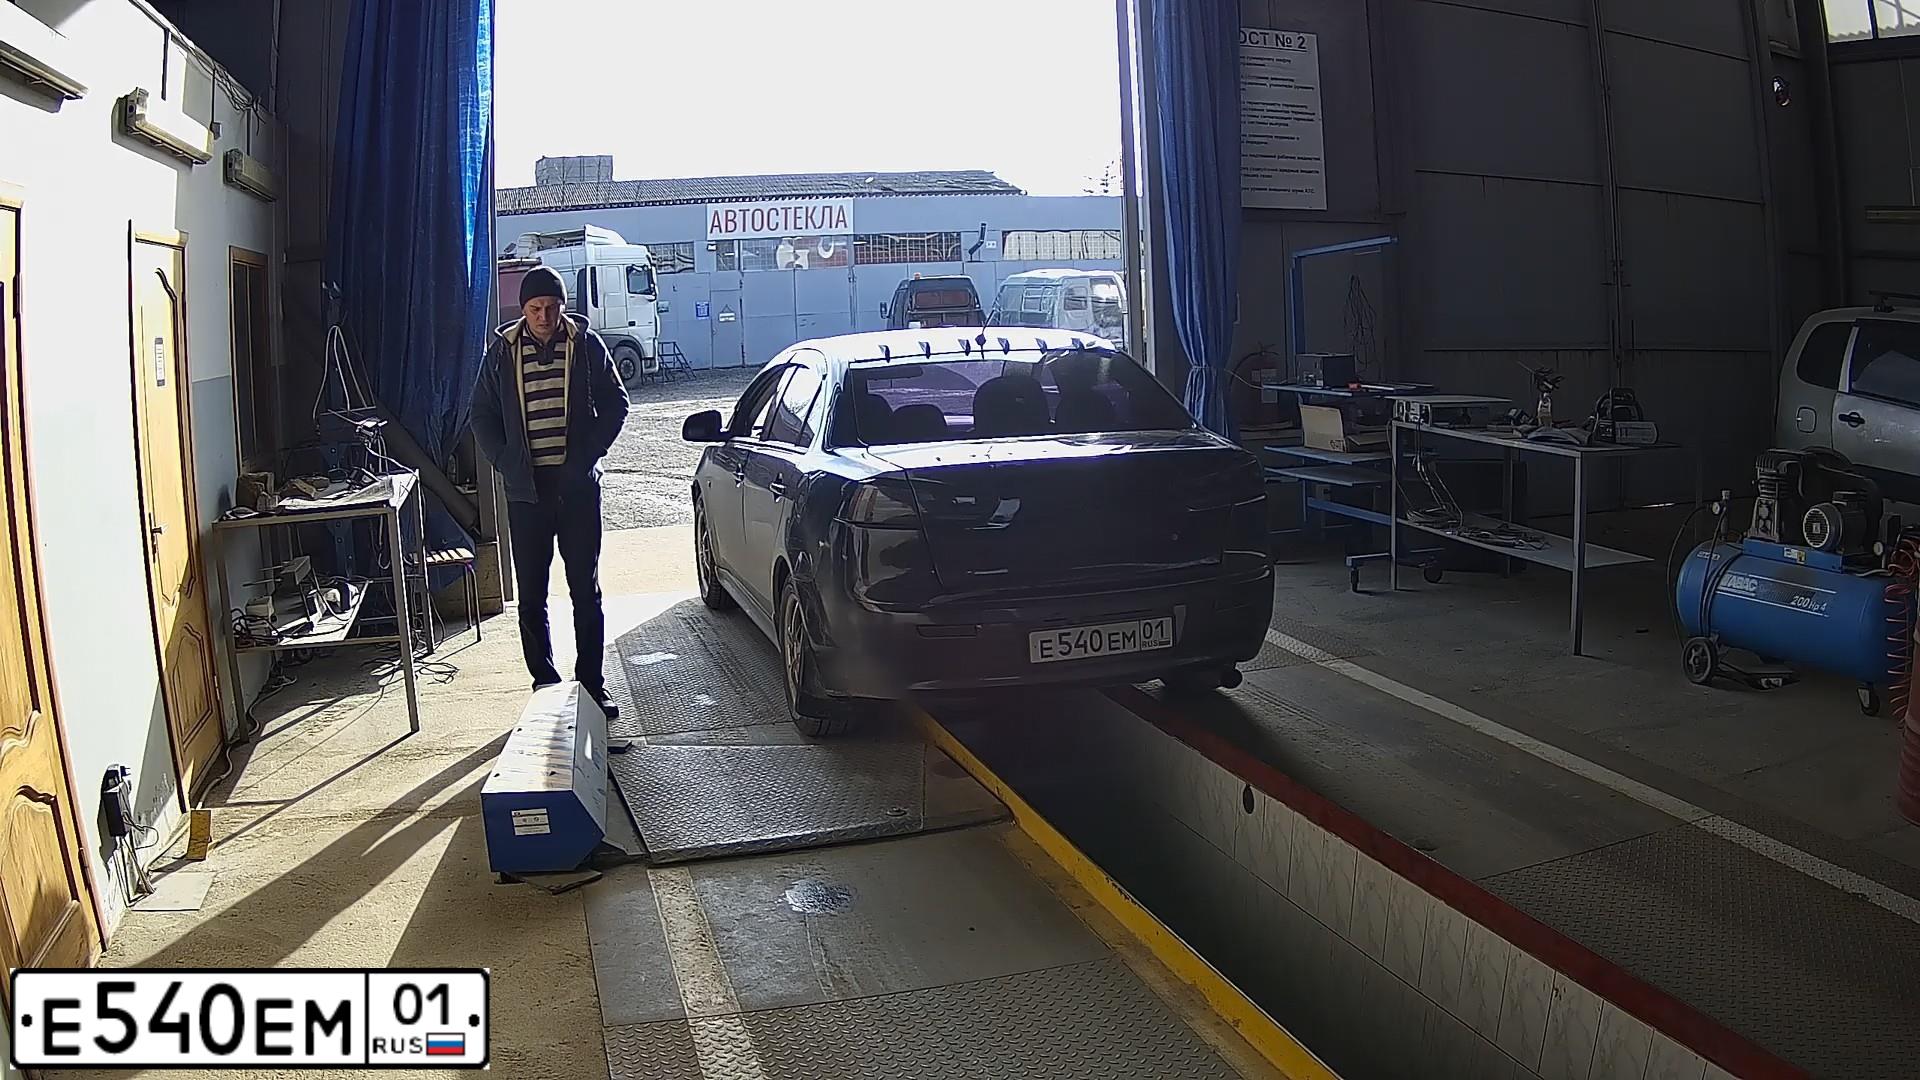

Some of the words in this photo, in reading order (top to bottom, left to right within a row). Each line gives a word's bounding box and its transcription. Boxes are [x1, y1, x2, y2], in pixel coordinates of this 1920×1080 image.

[1297, 36, 1307, 49] 2
[709, 204, 848, 234] АВТОСТЕКЛА
[1142, 620, 1164, 639] 01
[1142, 639, 1159, 648] RUS
